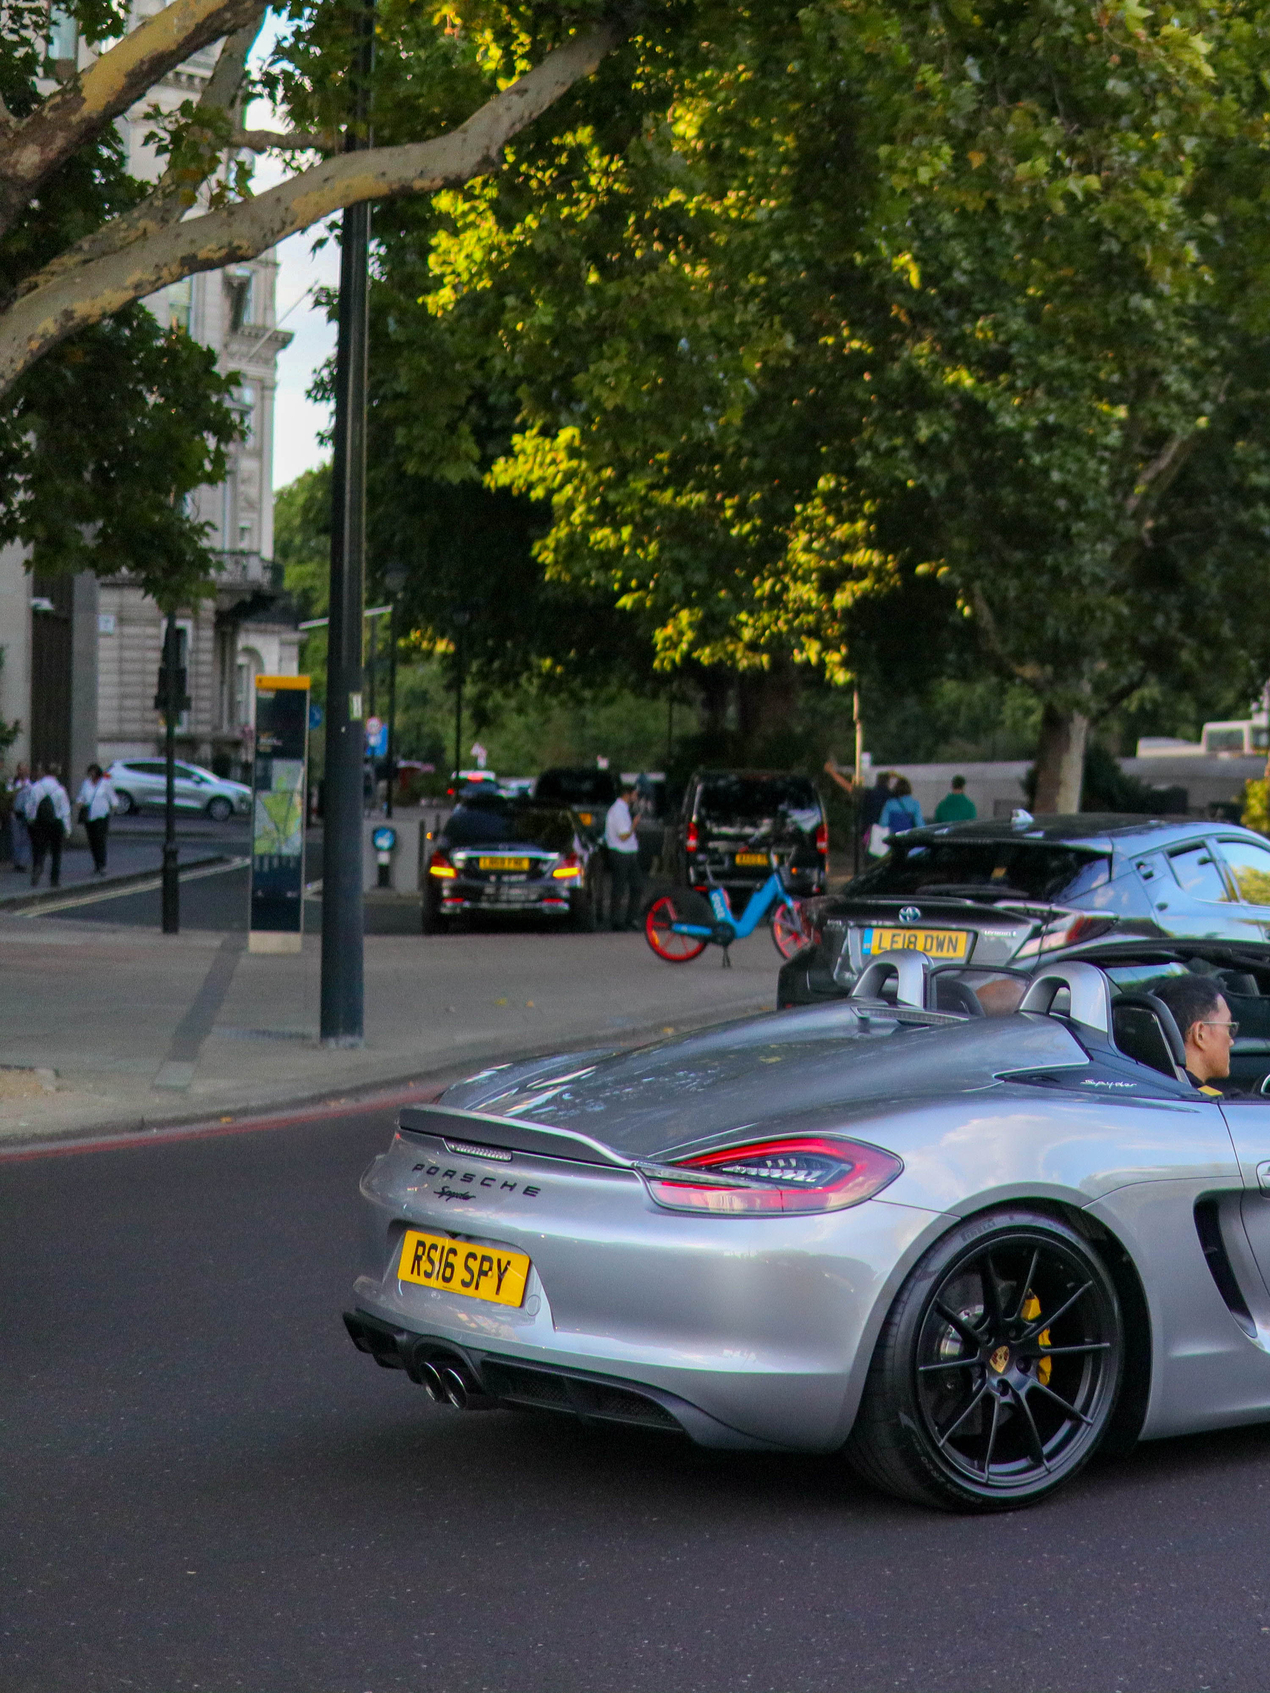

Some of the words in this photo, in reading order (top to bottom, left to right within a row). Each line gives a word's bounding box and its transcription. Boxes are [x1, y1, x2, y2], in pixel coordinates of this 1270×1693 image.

[878, 932, 918, 951] LE18
[923, 935, 959, 954] DWN
[1080, 1079, 1137, 1090] Spyder
[411, 1163, 541, 1197] PORSCHE
[433, 1185, 476, 1202] Spyder
[410, 1239, 458, 1284] RS16
[460, 1251, 511, 1296] SPY
